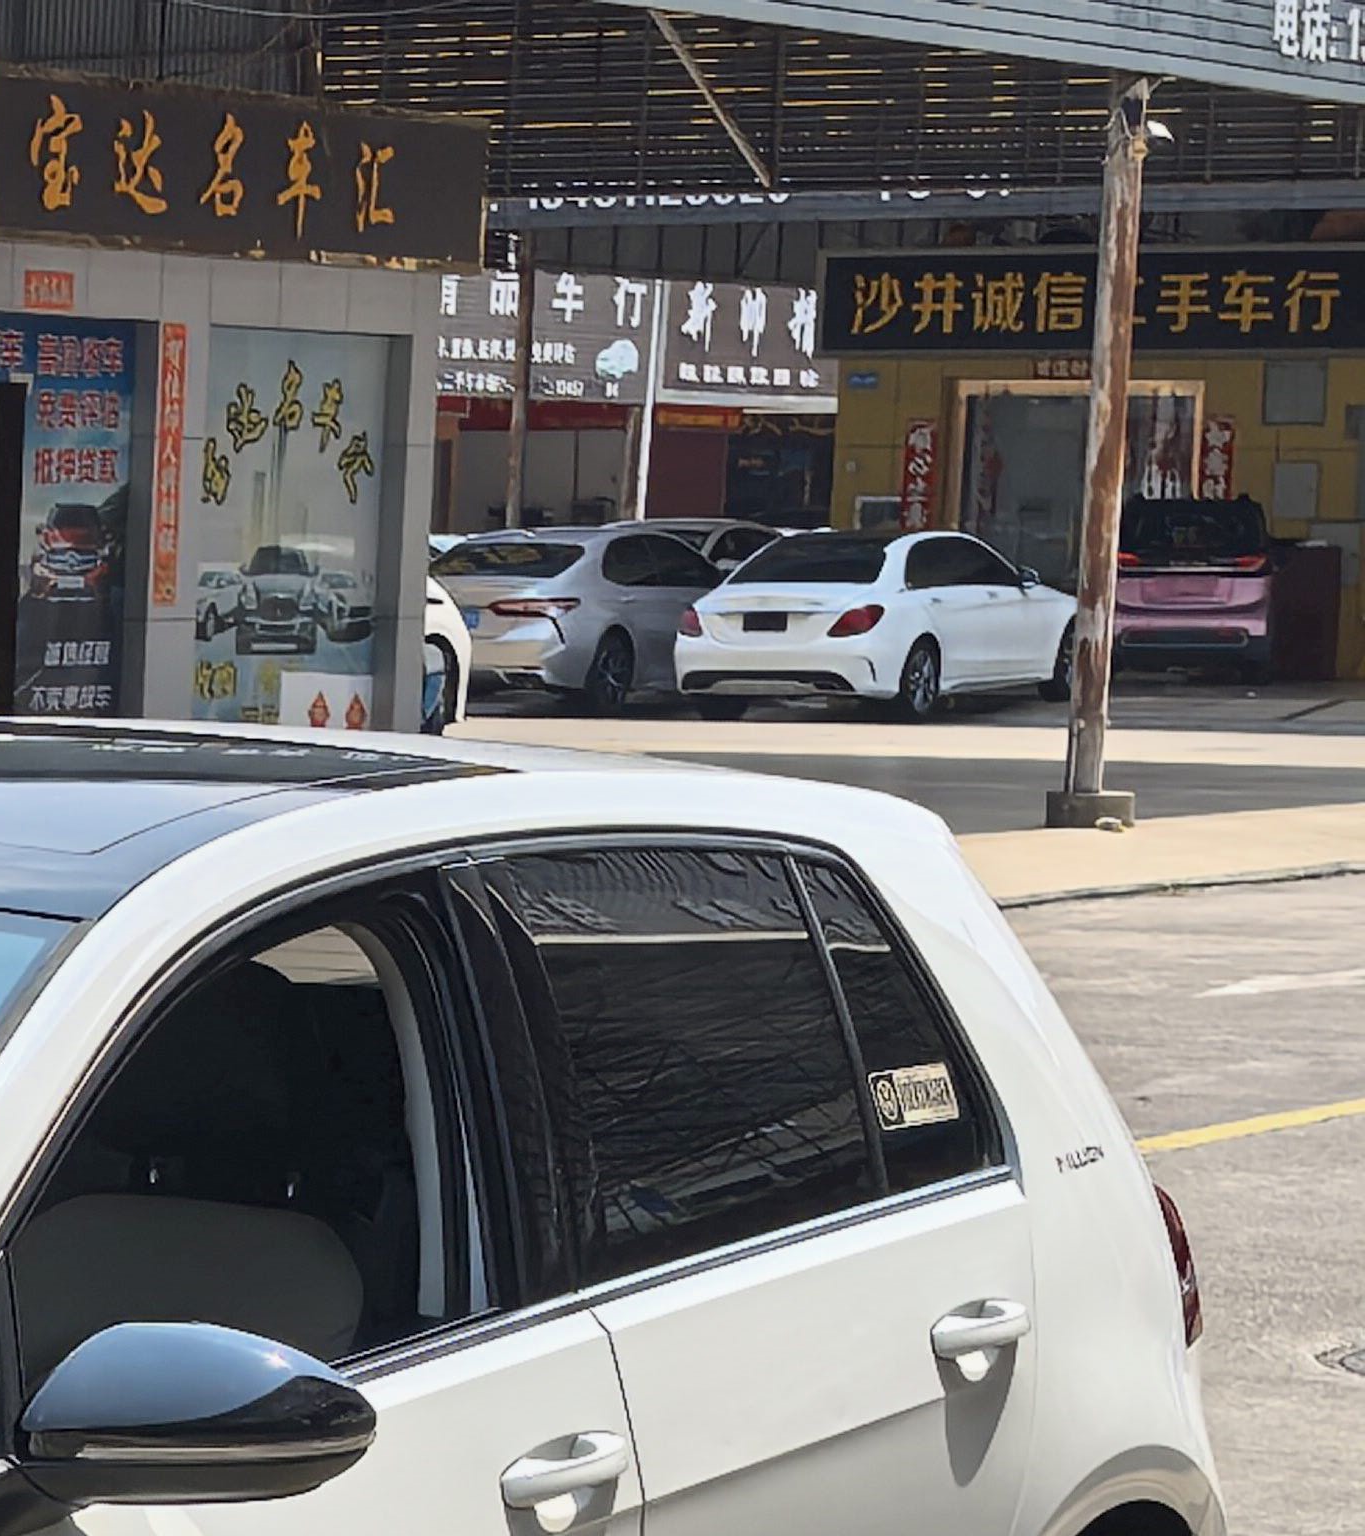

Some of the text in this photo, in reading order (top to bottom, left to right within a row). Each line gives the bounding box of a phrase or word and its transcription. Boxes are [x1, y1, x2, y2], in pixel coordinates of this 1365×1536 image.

[29, 93, 396, 239] 宝达名车汇
[850, 271, 1341, 335] 沙井诚信手车行
